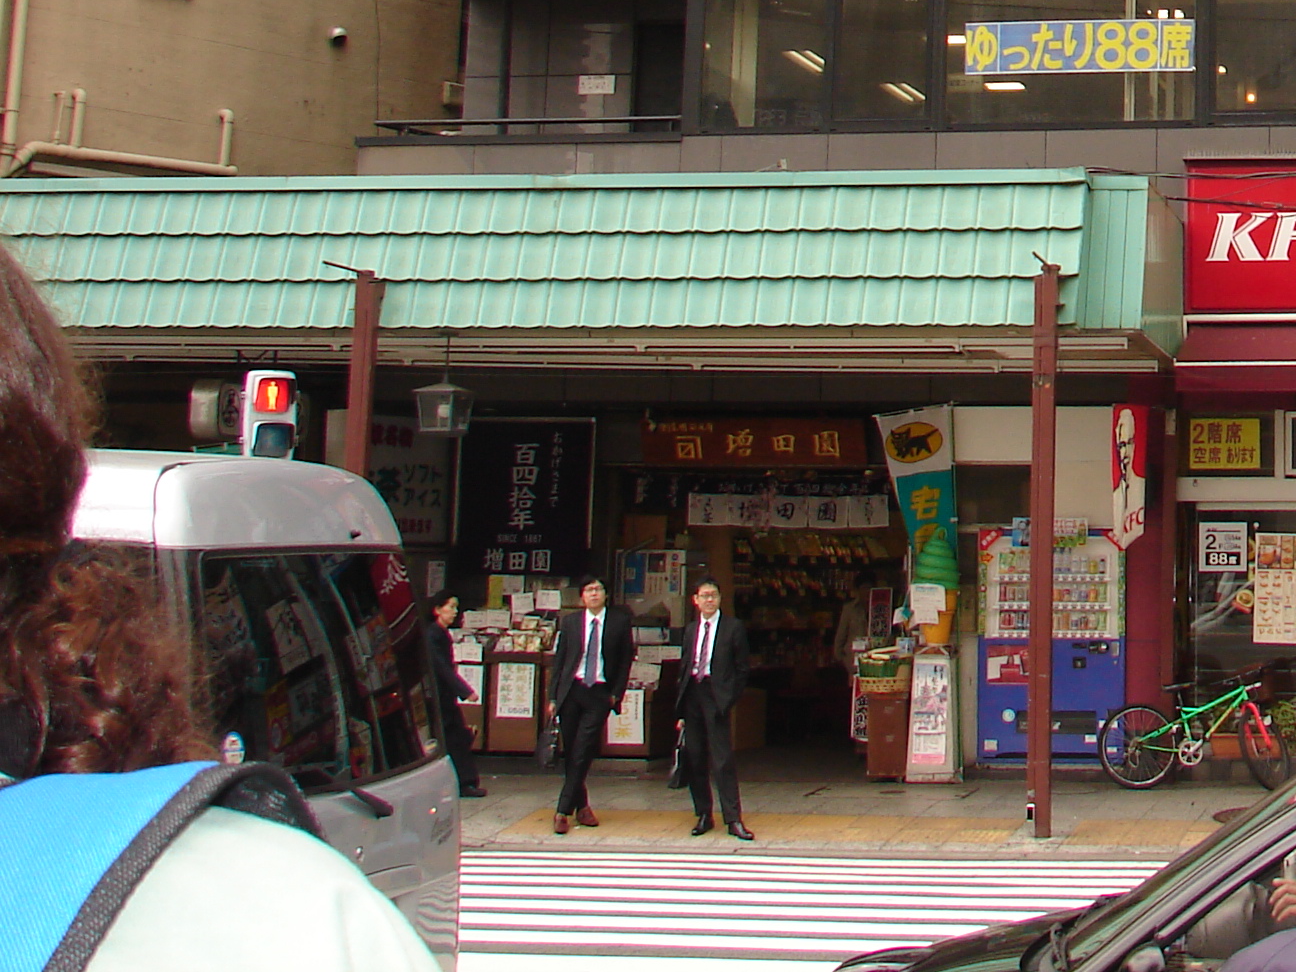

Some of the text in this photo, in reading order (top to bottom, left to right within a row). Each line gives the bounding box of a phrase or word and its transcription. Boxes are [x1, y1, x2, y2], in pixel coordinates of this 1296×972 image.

[966, 21, 1191, 71] ゆったり88席
[1193, 421, 1242, 444] 2階席
[1194, 447, 1257, 464] 空席 あります
[508, 443, 541, 531] 百四拾年
[497, 533, 518, 544] SINCE
[484, 547, 552, 573] 増田園
